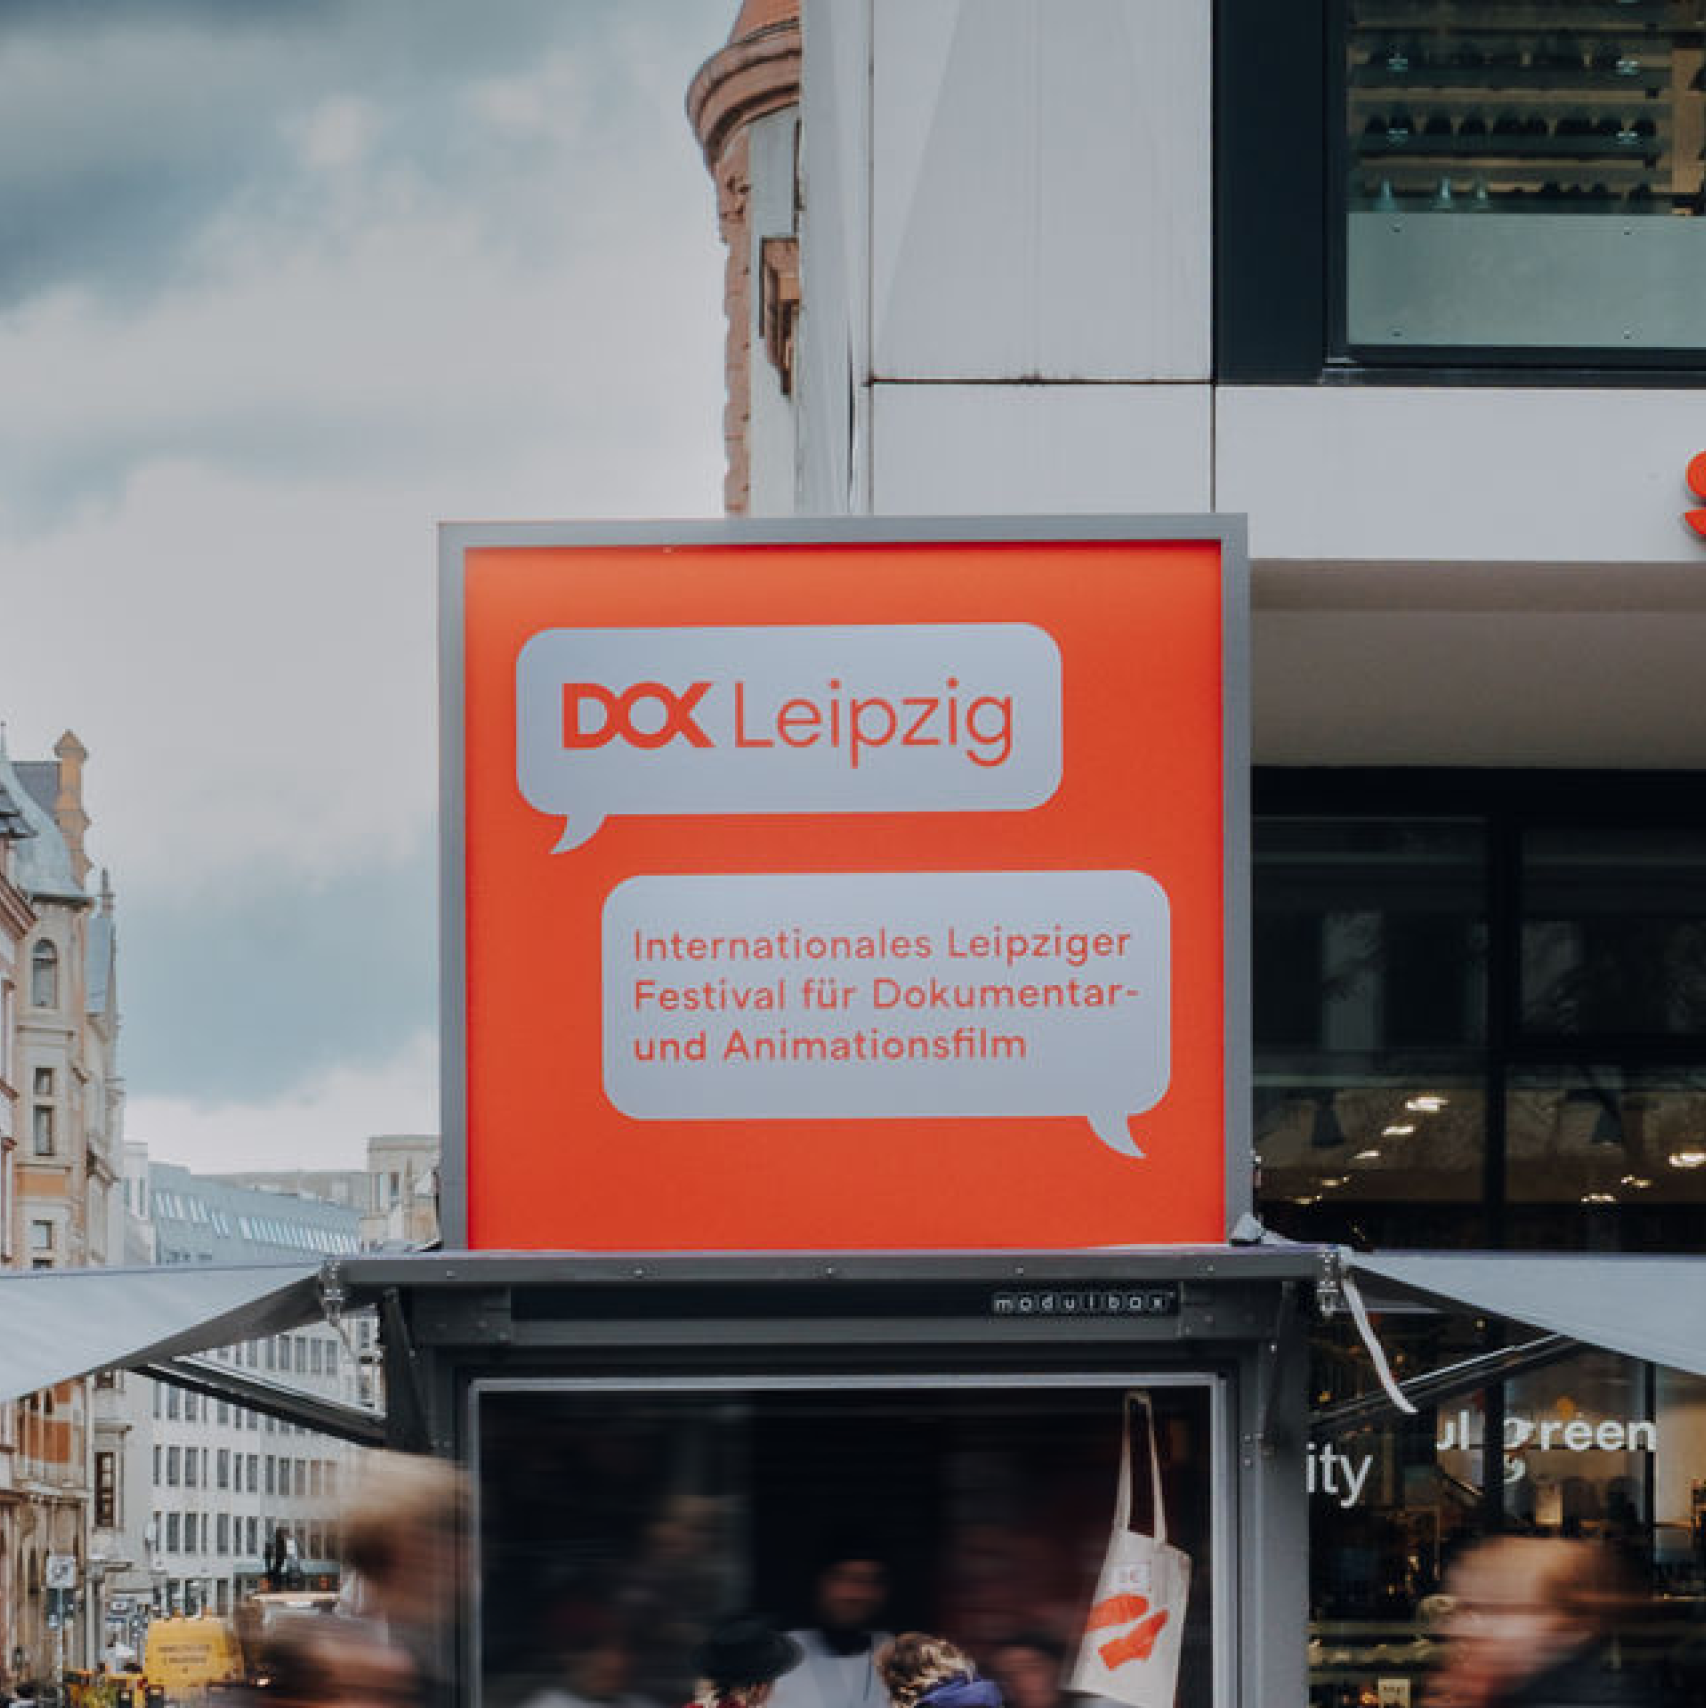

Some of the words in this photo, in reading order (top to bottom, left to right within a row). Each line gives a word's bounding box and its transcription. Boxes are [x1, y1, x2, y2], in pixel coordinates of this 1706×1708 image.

[734, 677, 1014, 770] Leipzig
[633, 928, 932, 961] Internationales
[947, 925, 1132, 967] Leipziger
[633, 976, 787, 1011] Festival
[801, 976, 858, 1010] für
[872, 976, 1140, 1010] Dokumentar-
[633, 1030, 707, 1062] und
[723, 1026, 1026, 1061] Animationsfilm
[1305, 1442, 1374, 1508] ity
